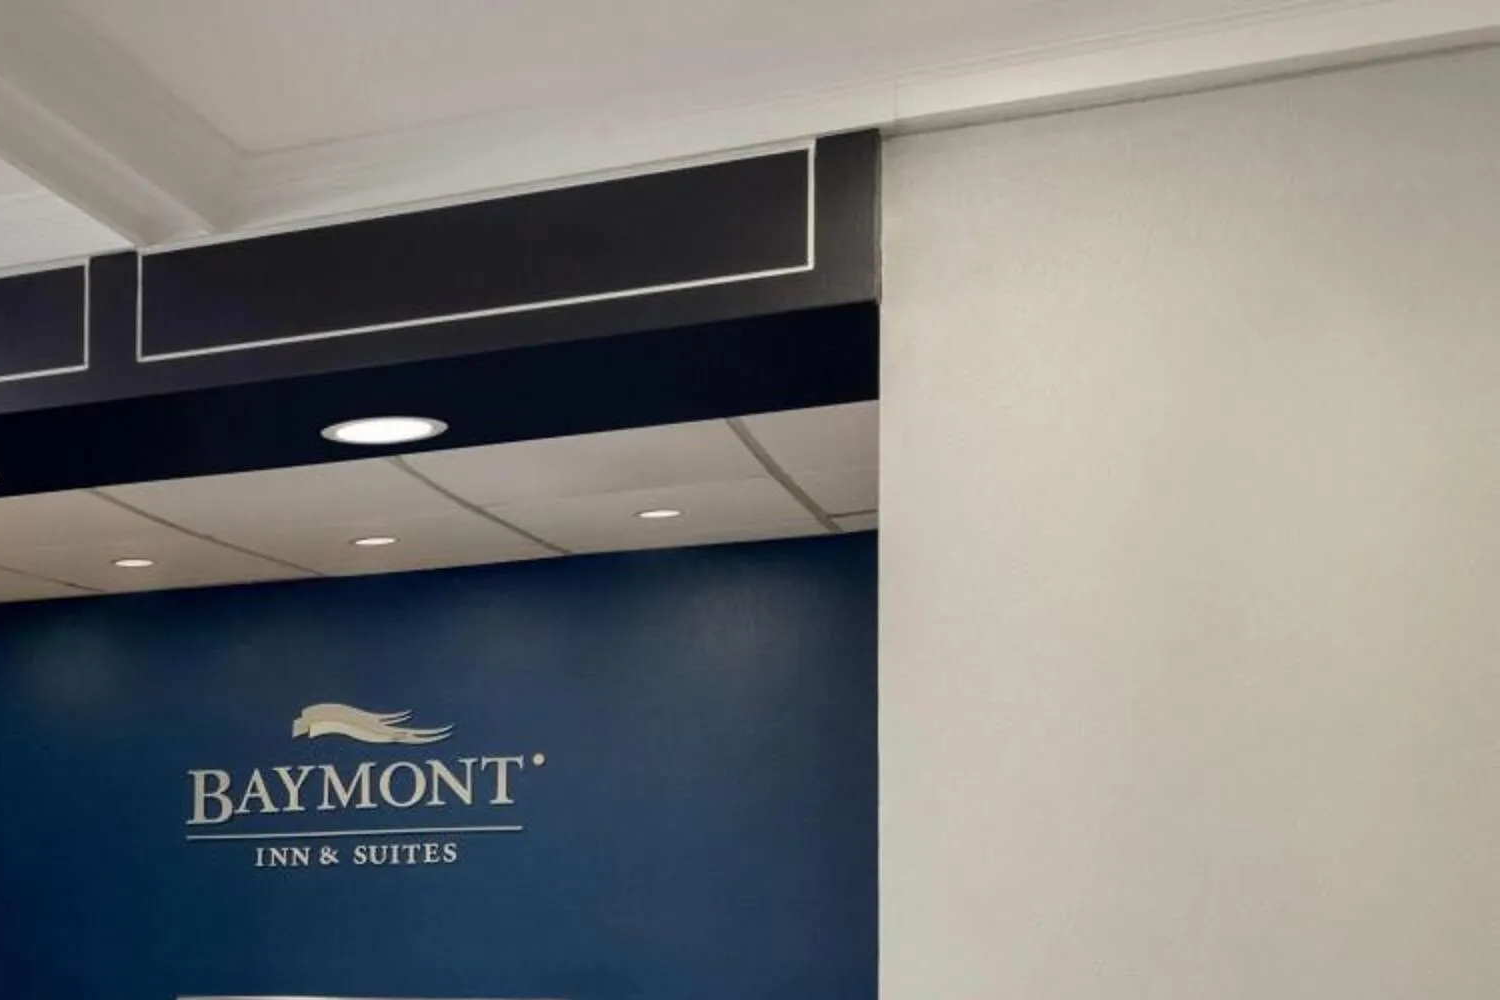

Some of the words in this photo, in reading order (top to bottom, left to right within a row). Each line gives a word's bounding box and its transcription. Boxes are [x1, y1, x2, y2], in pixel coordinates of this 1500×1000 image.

[186, 755, 525, 825] BAYMONT
[255, 846, 310, 867] INN
[319, 846, 339, 866] &
[353, 842, 458, 866] SUITES
